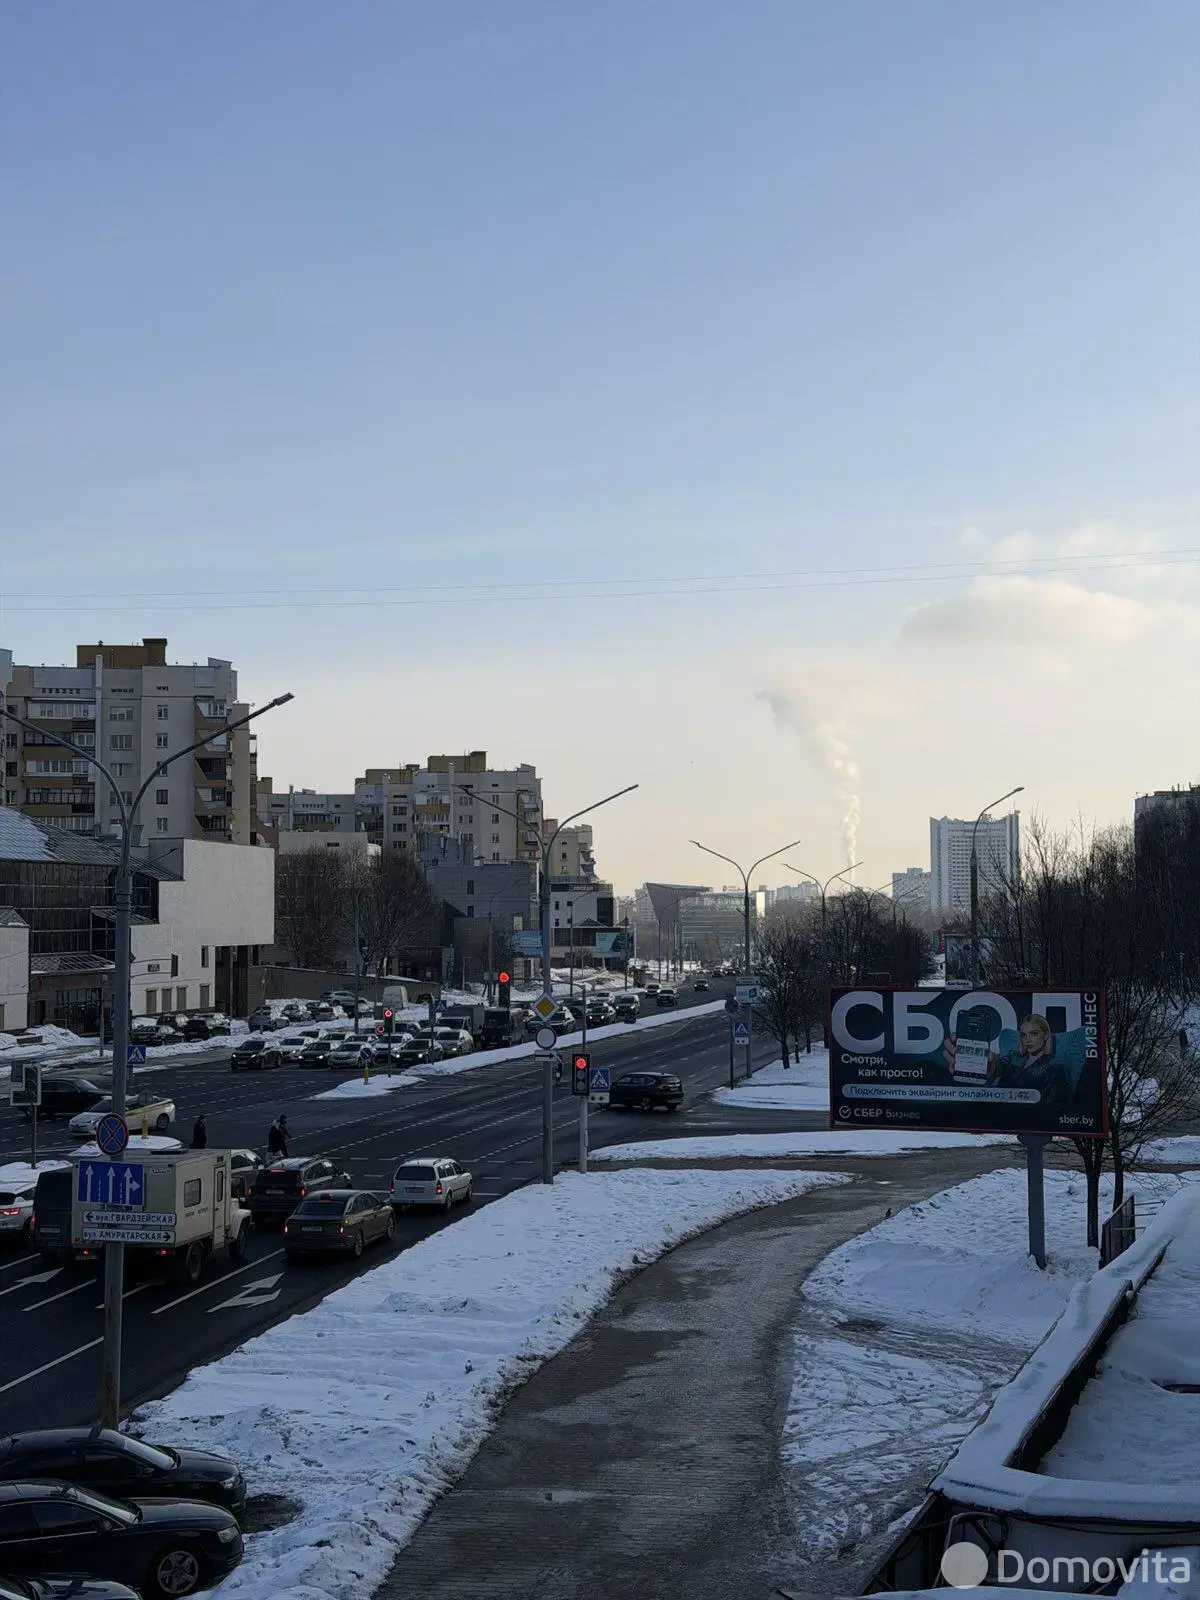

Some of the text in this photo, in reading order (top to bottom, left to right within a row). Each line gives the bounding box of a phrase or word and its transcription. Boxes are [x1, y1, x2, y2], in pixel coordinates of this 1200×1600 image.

[1085, 992, 1098, 1058] БИЗНЕС
[841, 1054, 888, 1066] Смотри,
[858, 1068, 924, 1080] как просто!
[850, 1086, 907, 1098] Подключить
[908, 1089, 957, 1100] эквайринг
[958, 1089, 993, 1099] онлайн
[854, 1107, 921, 1120] СБЕР Бизнес
[1059, 1114, 1094, 1127] sber.by
[99, 1231, 162, 1240] АМУРАТАРСКАЯ
